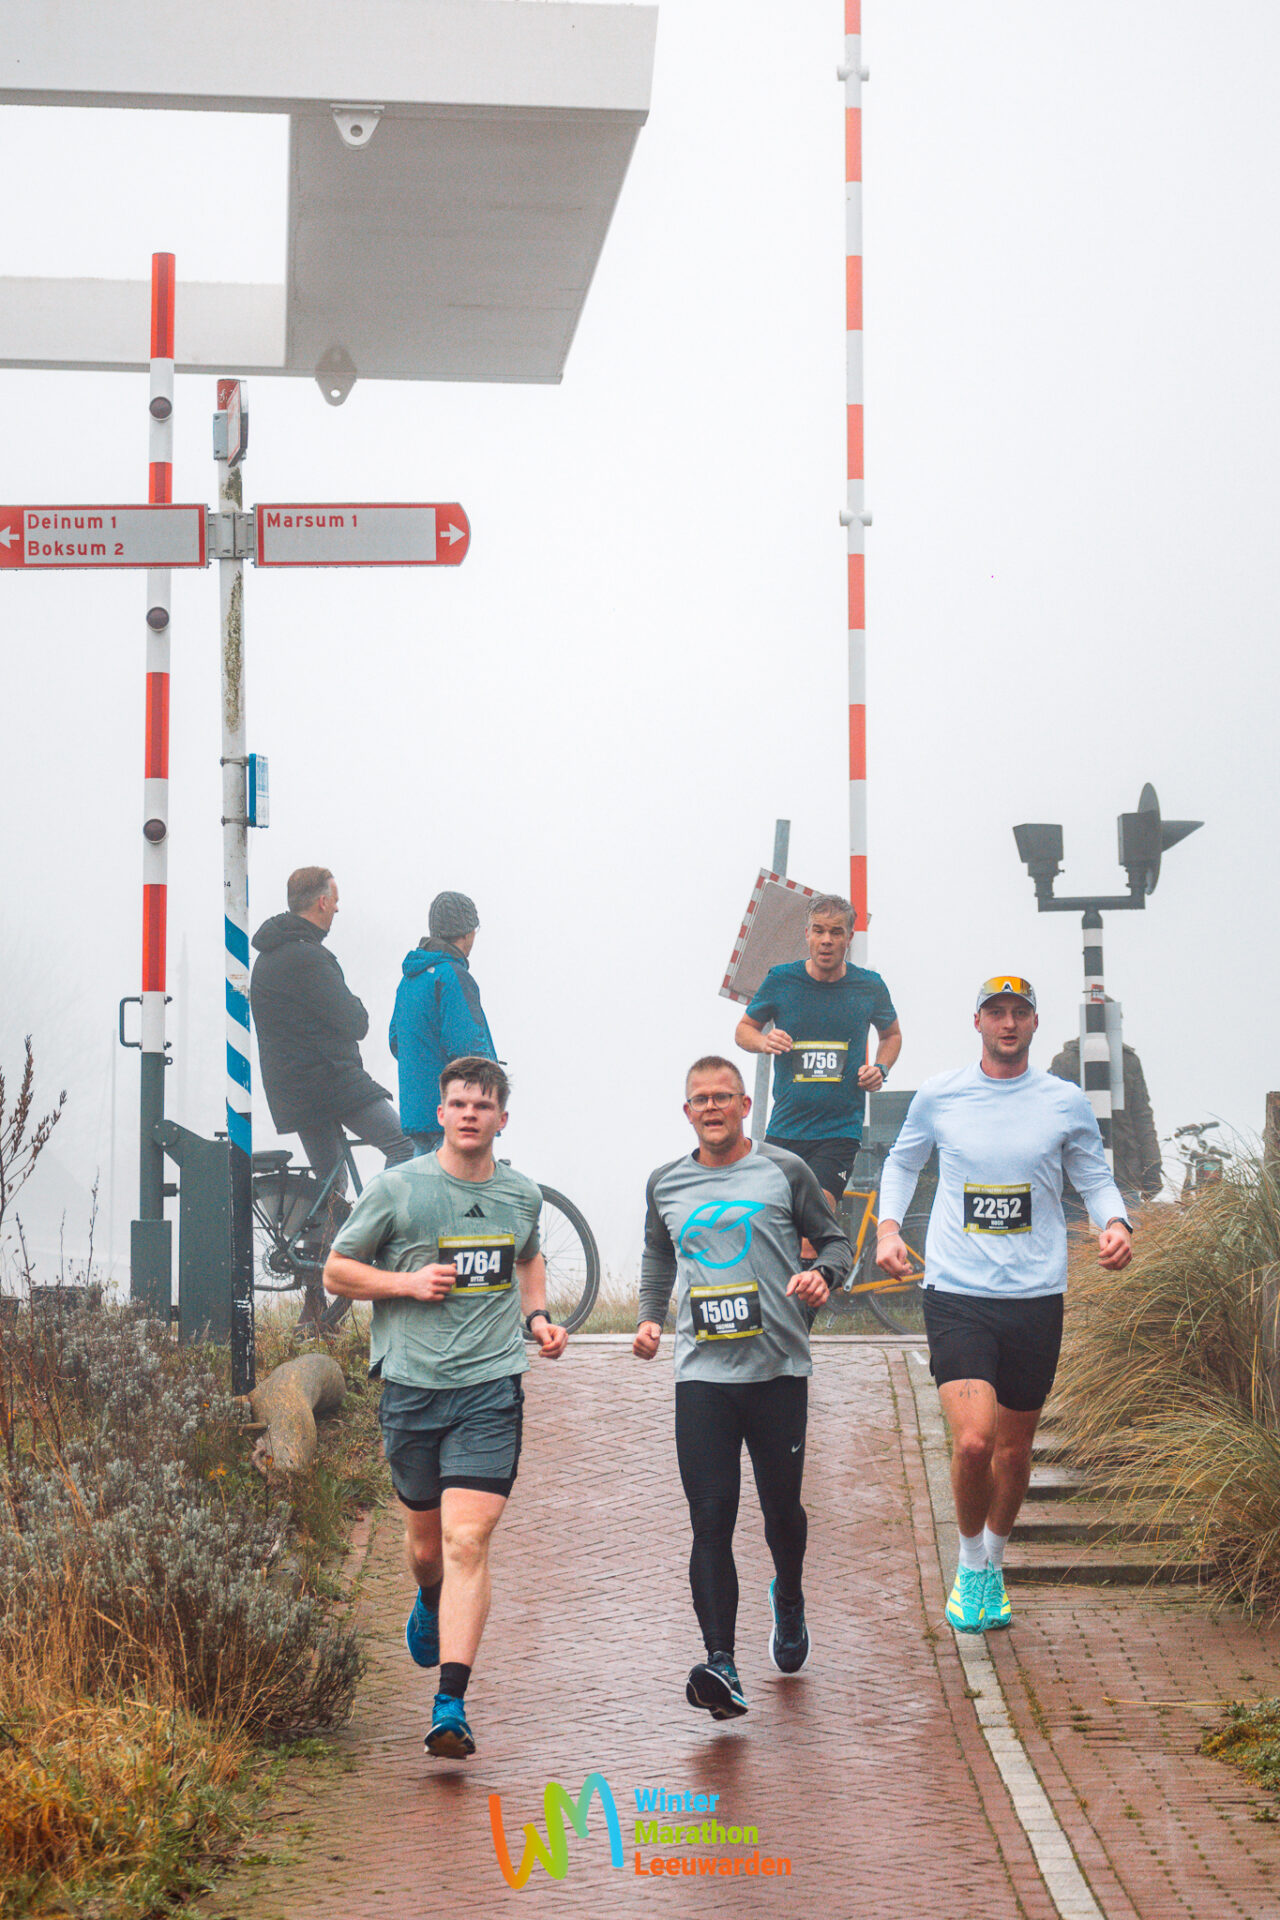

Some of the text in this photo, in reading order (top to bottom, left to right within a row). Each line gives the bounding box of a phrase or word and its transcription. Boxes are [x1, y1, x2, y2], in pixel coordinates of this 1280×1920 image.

[28, 514, 117, 529] Deinum 1
[267, 512, 358, 528] Marsum 1
[28, 541, 125, 556] Boksum 2
[801, 1052, 838, 1070] 1756
[972, 1197, 1022, 1219] 2252
[453, 1250, 501, 1276] 1764
[699, 1297, 749, 1324] 1506
